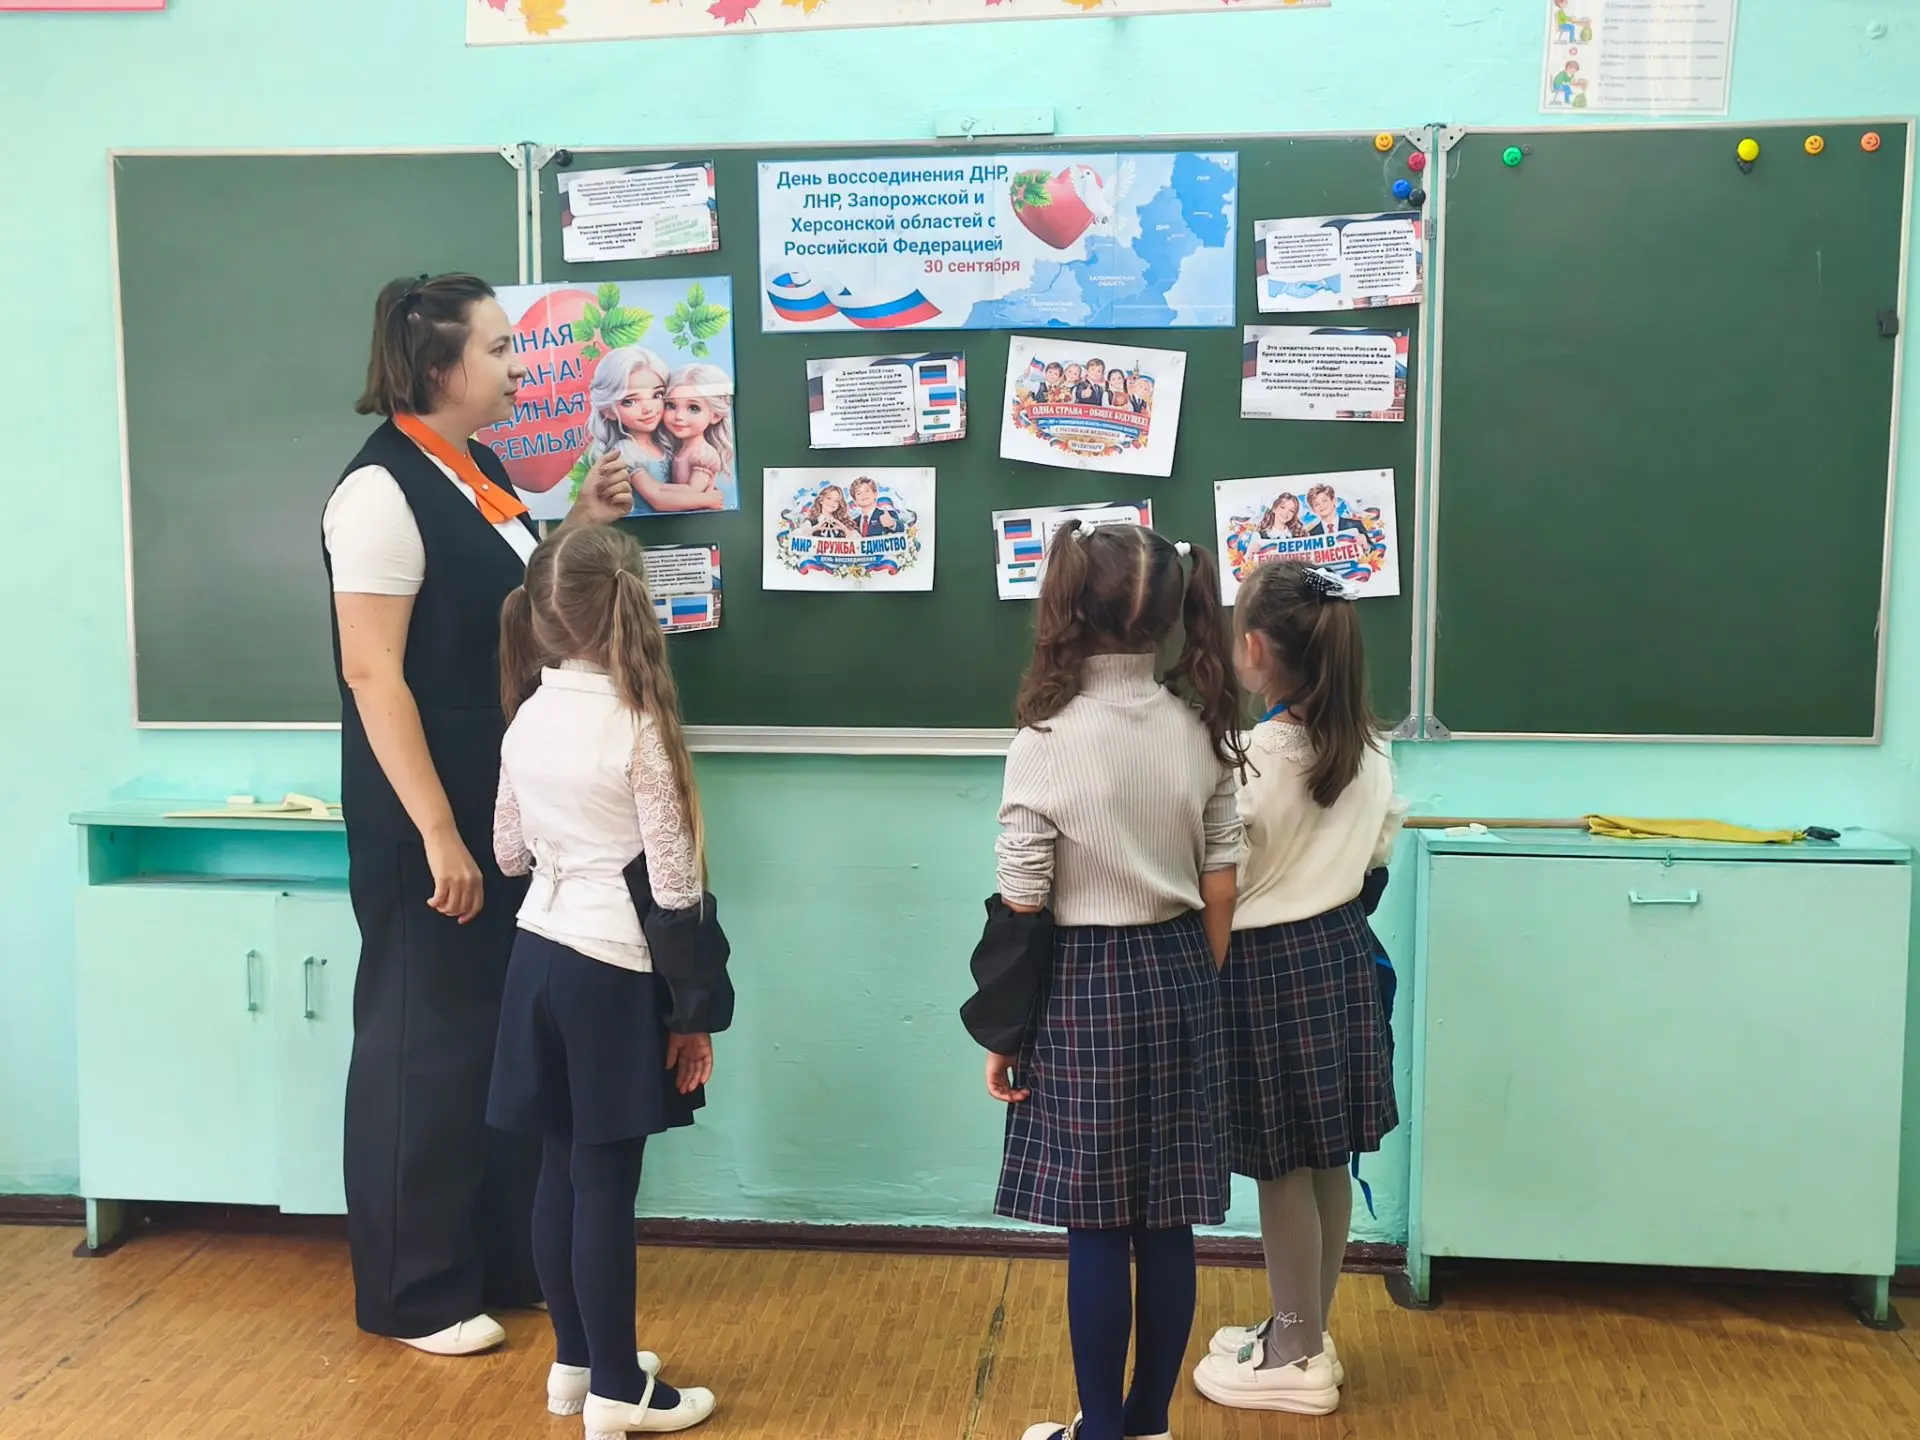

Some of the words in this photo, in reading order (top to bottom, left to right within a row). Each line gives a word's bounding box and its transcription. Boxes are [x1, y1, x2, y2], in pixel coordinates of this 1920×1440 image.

[777, 170, 822, 191] День
[828, 170, 964, 185] воссоединения
[969, 165, 1009, 185] ДНР,
[803, 193, 842, 211] ЛНР,
[848, 191, 968, 209] Запорожской
[974, 193, 984, 204] и
[792, 217, 896, 236] Херсонской
[901, 213, 983, 230] областей
[988, 217, 996, 228] с
[784, 238, 889, 257] Российской
[893, 235, 1003, 256] Федерацией
[924, 259, 943, 273] 30
[948, 257, 1020, 274] сентября
[1032, 406, 1054, 415] ОДНА
[1056, 407, 1082, 416] СТРАНА
[491, 427, 584, 461] СЕМЬЯ!
[791, 537, 812, 552] МИР
[816, 540, 856, 554] ДРУЖБА
[860, 536, 906, 554] ЕДИНСТВО
[1278, 538, 1324, 553] ВЕРИМ
[1326, 536, 1336, 548] В
[1314, 544, 1360, 562] ВМЕСТЕ!
